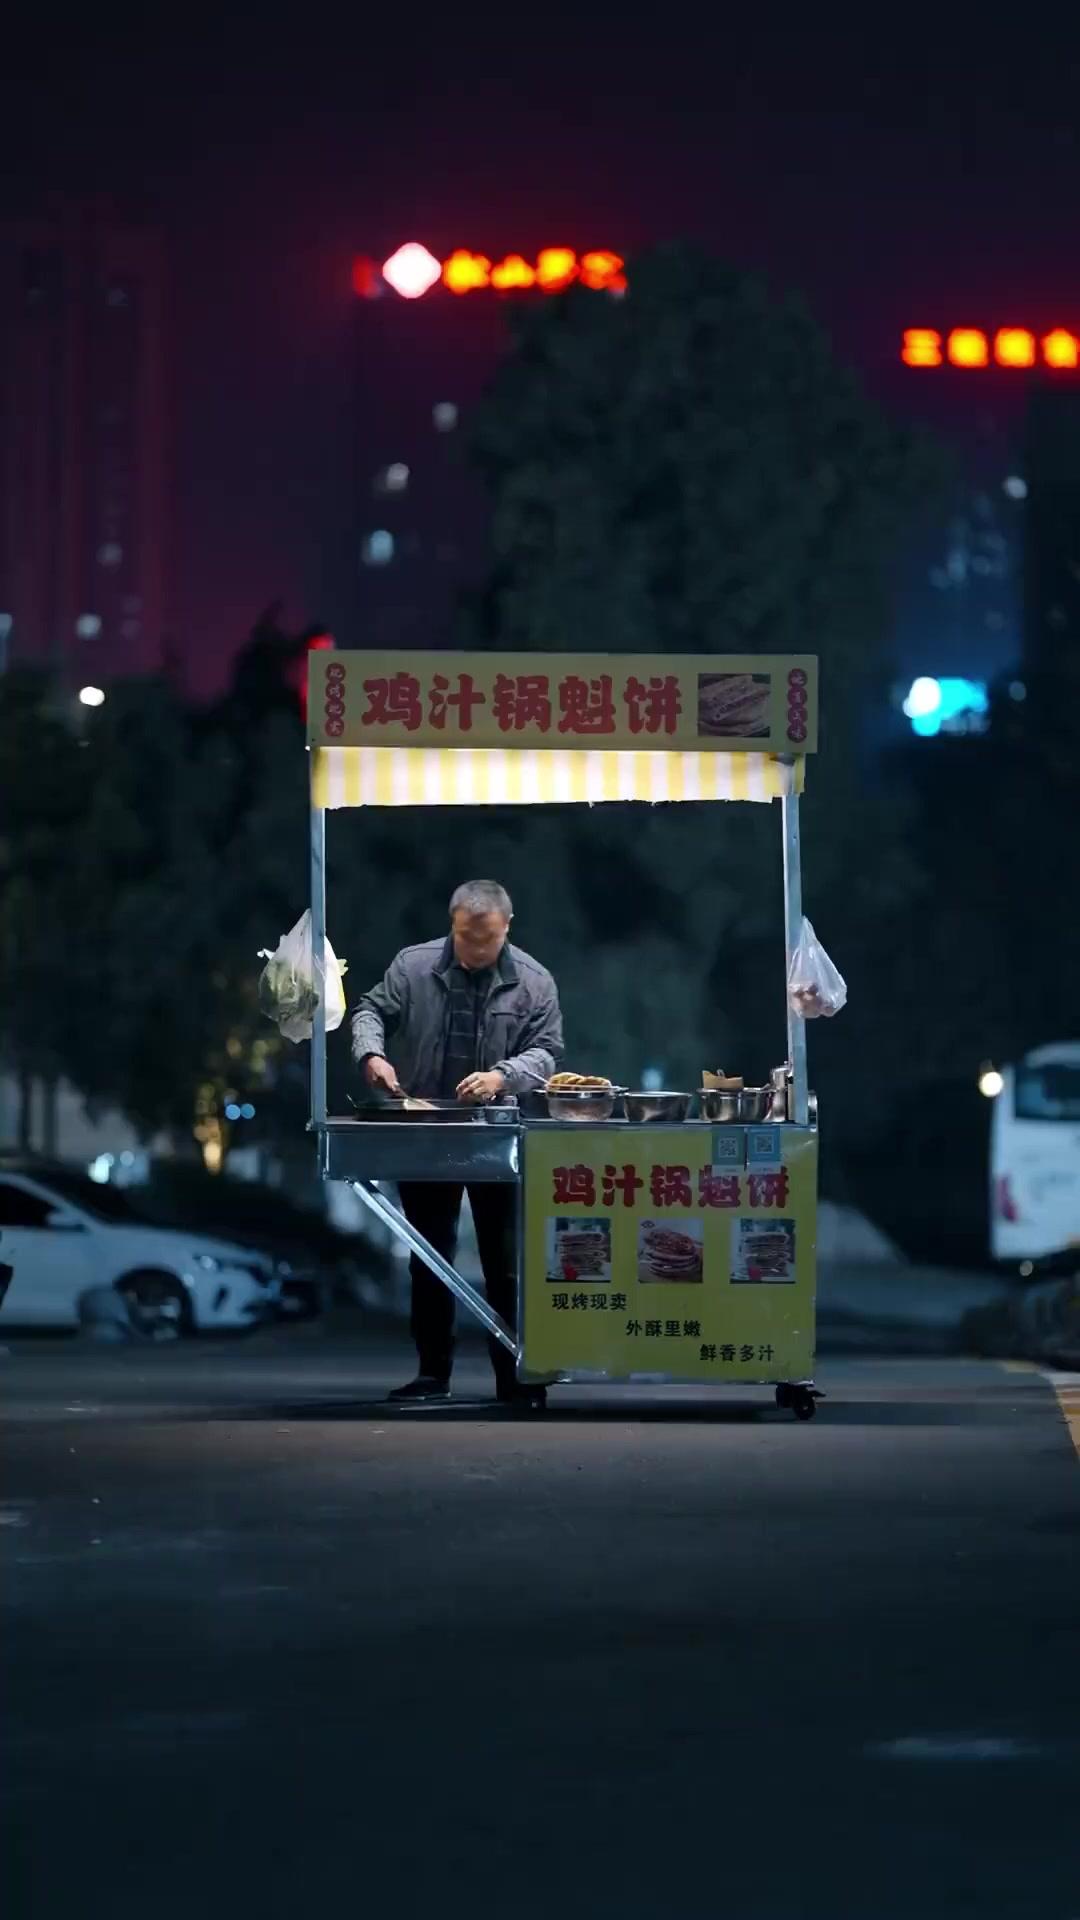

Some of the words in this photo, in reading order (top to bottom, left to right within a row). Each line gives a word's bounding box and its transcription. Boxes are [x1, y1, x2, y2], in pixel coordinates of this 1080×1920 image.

[361, 672, 682, 735] 鸡汁锅魁饼
[551, 1293, 627, 1311] 现烤现卖
[625, 1319, 701, 1337] 外酥里嫩
[699, 1344, 775, 1362] 鲜香多汁
